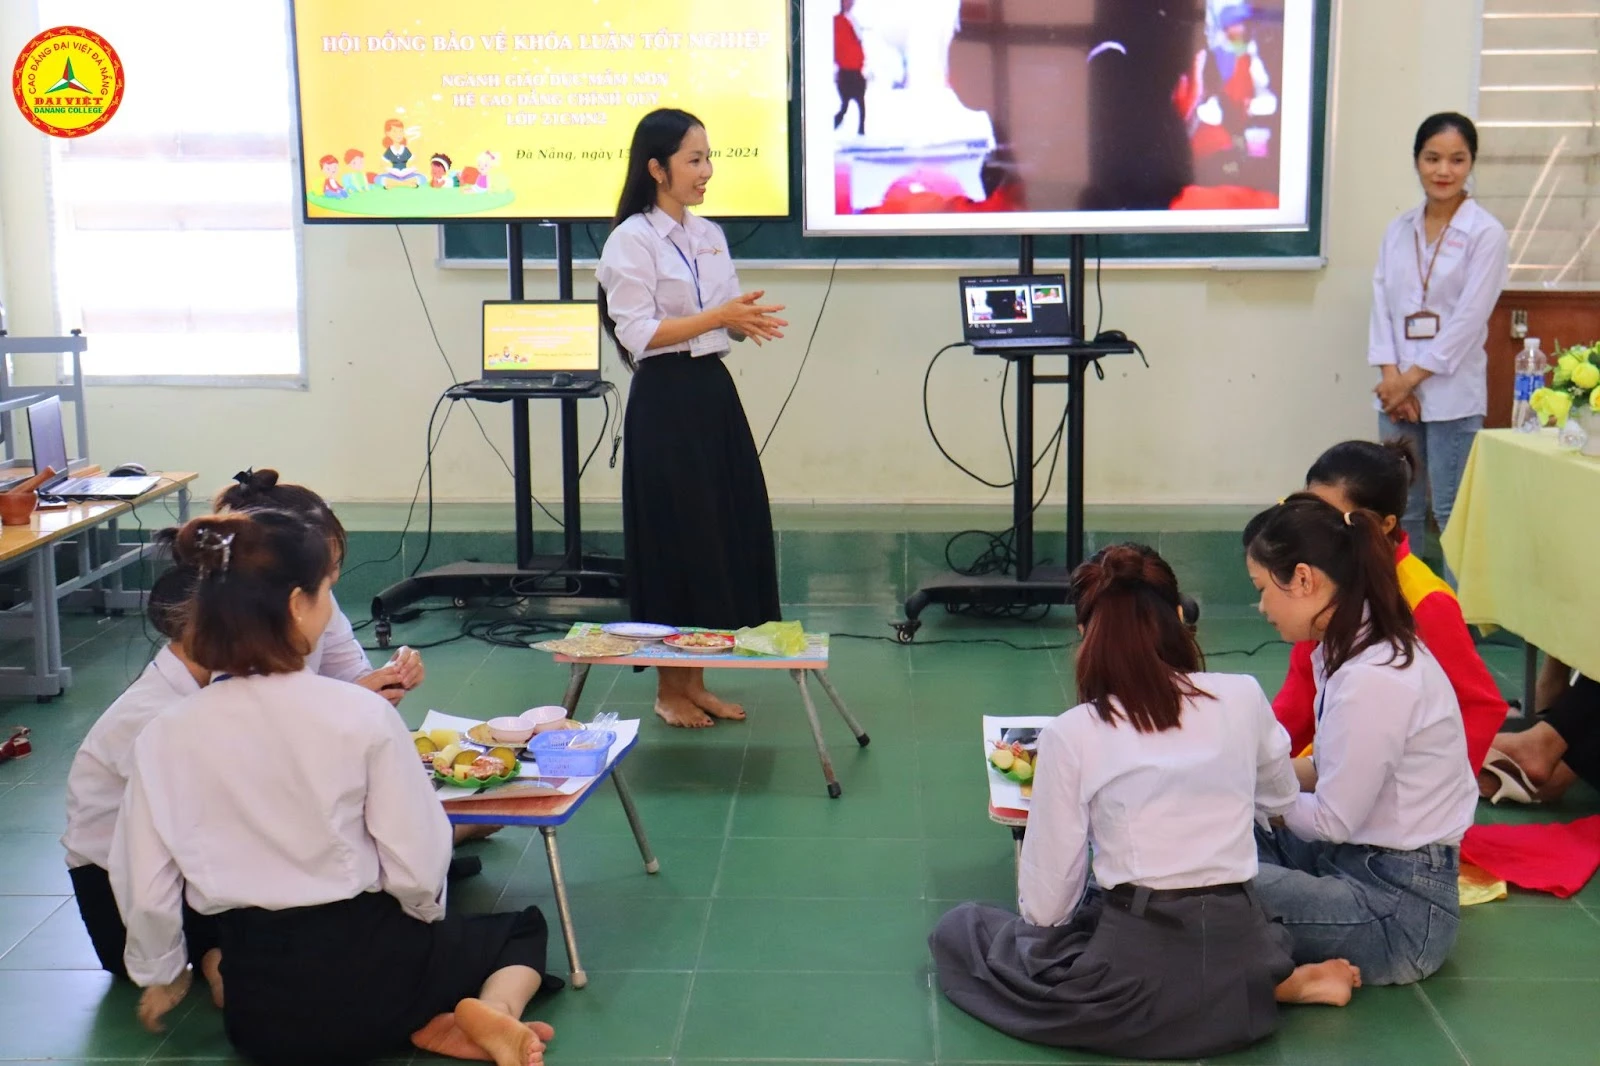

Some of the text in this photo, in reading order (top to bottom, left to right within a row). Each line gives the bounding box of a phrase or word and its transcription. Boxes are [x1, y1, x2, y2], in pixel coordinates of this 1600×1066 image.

[322, 28, 771, 55] HỘI ĐỒNG BẢO VỆ KHÓA LUẬN TỐT NGHIỆP
[453, 91, 476, 107] HỆ
[479, 94, 513, 107] CAO
[626, 92, 660, 107] QUY
[516, 148, 533, 159] Đà
[581, 148, 614, 161] ngày
[726, 147, 759, 158] 2024
